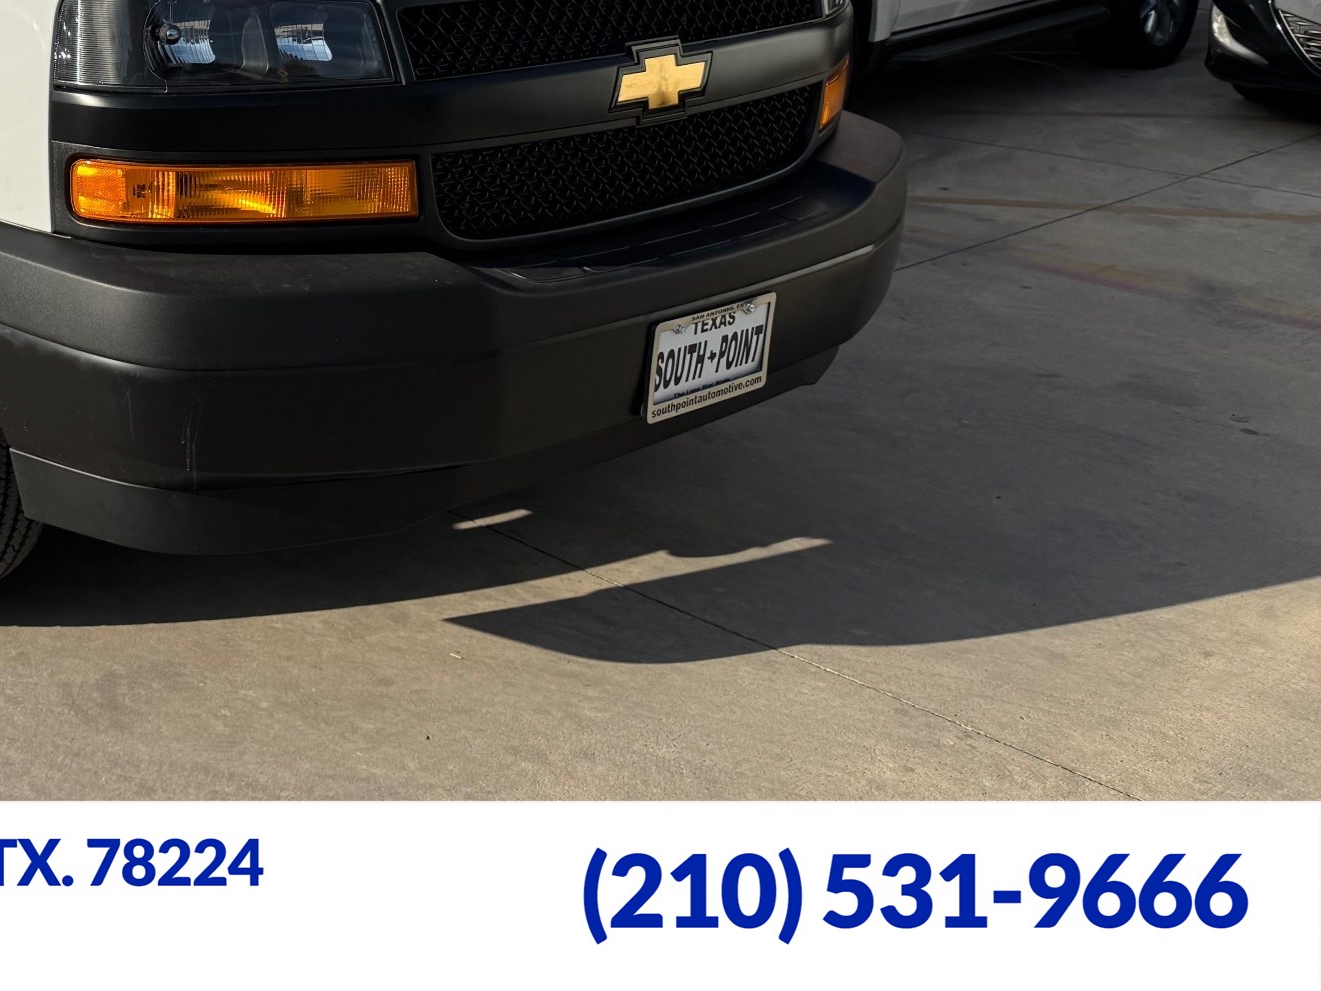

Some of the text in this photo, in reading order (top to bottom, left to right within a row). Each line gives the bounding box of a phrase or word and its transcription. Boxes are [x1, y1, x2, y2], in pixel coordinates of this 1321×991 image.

[693, 311, 736, 336] TEXAS
[654, 324, 764, 393] SOUTH POINT
[651, 375, 762, 419] southpointautomotive.com
